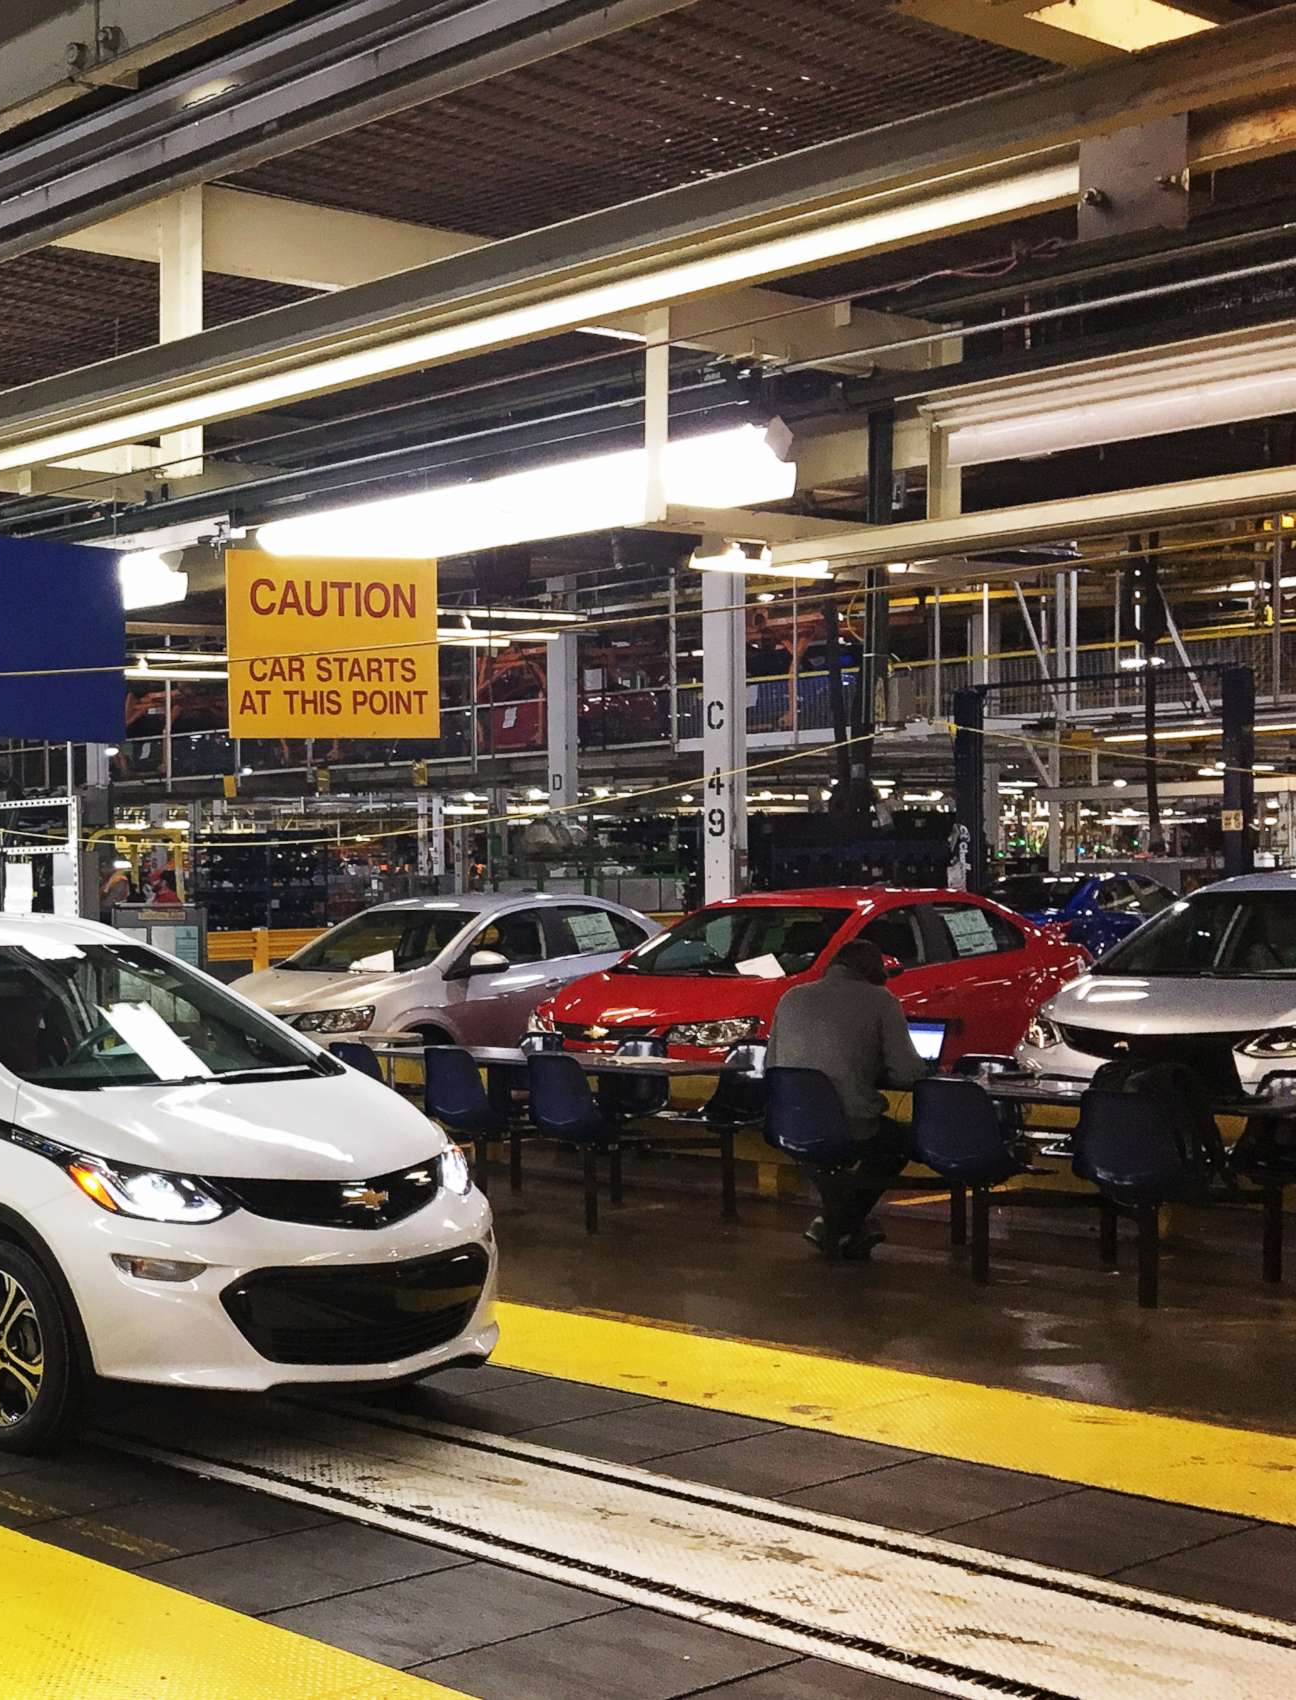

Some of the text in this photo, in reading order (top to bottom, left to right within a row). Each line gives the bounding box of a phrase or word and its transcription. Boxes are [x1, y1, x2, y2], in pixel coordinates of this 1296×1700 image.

[249, 578, 417, 619] CAUTION
[249, 655, 417, 683] CAR STARTS
[239, 689, 429, 716] AT THIS POINT
[552, 773, 563, 791] D
